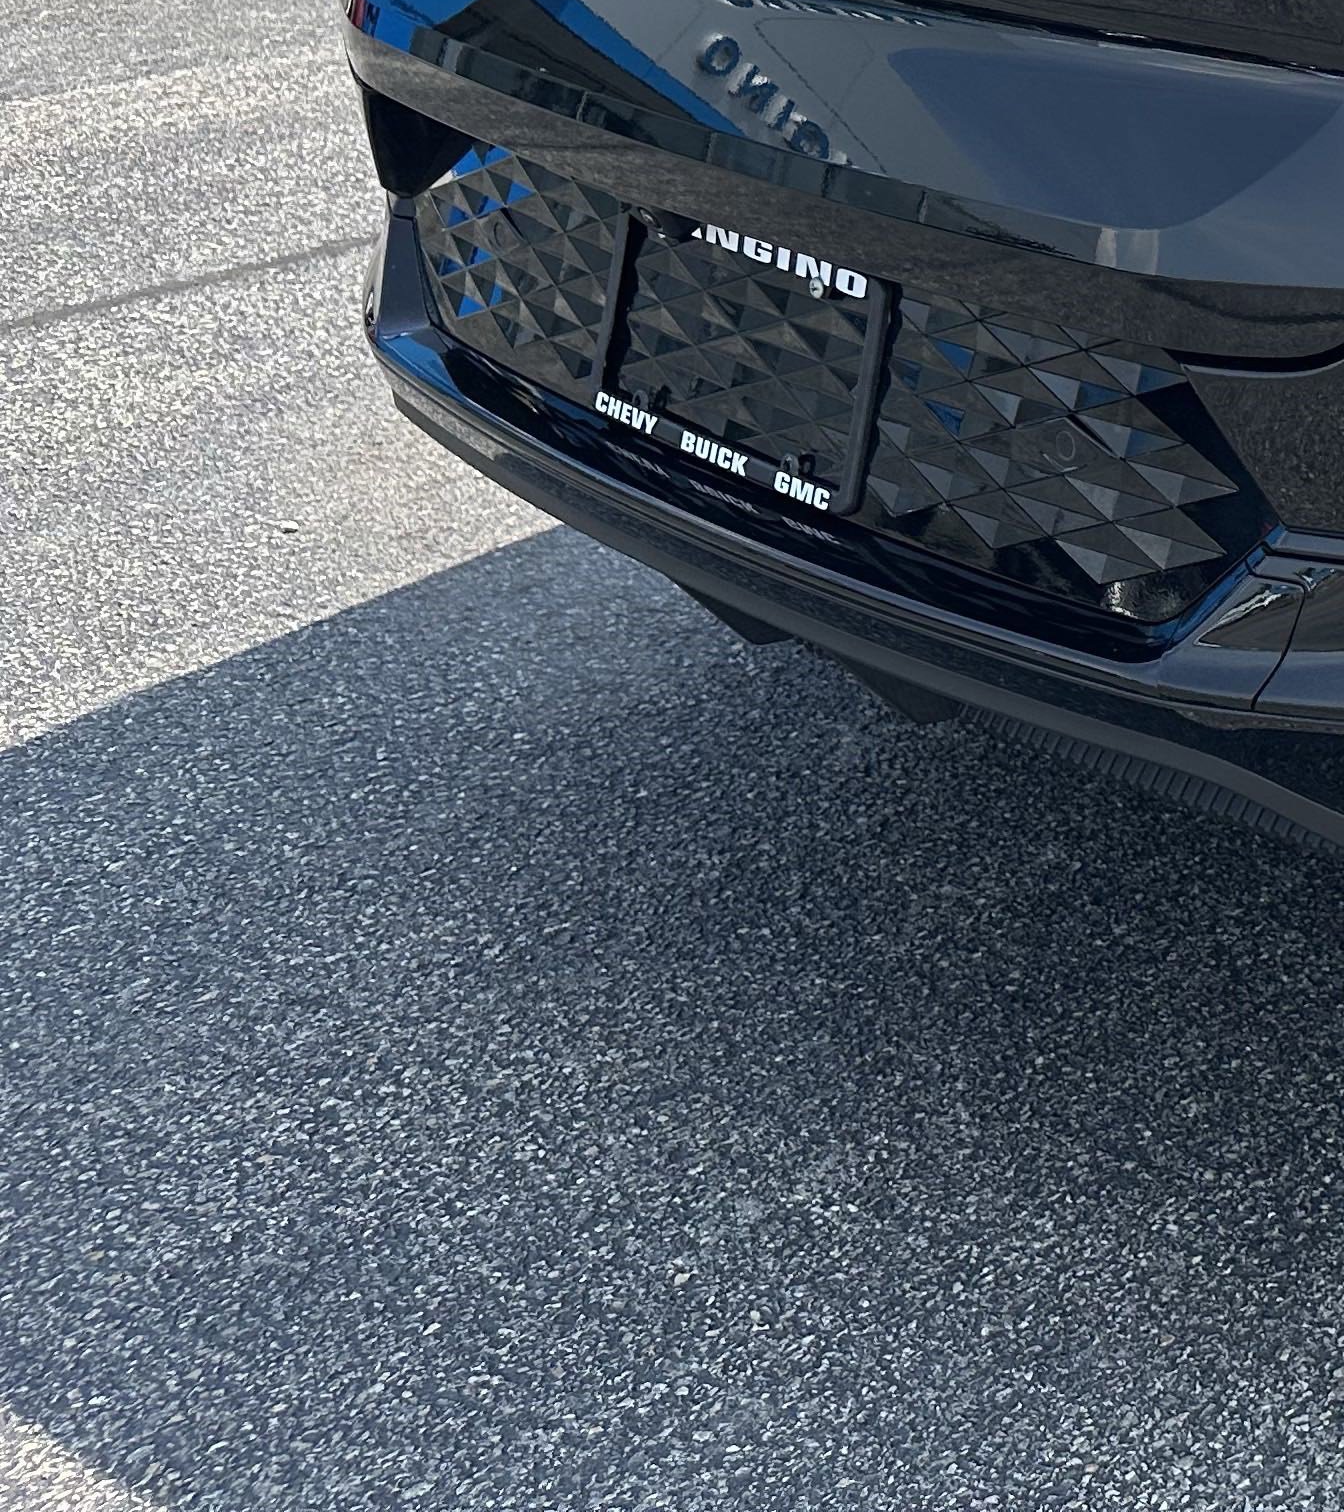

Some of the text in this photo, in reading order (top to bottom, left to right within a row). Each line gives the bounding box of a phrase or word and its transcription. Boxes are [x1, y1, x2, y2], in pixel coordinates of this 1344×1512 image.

[594, 391, 658, 435] CHEVY
[680, 430, 749, 477] BUICK
[773, 471, 831, 511] GMC
